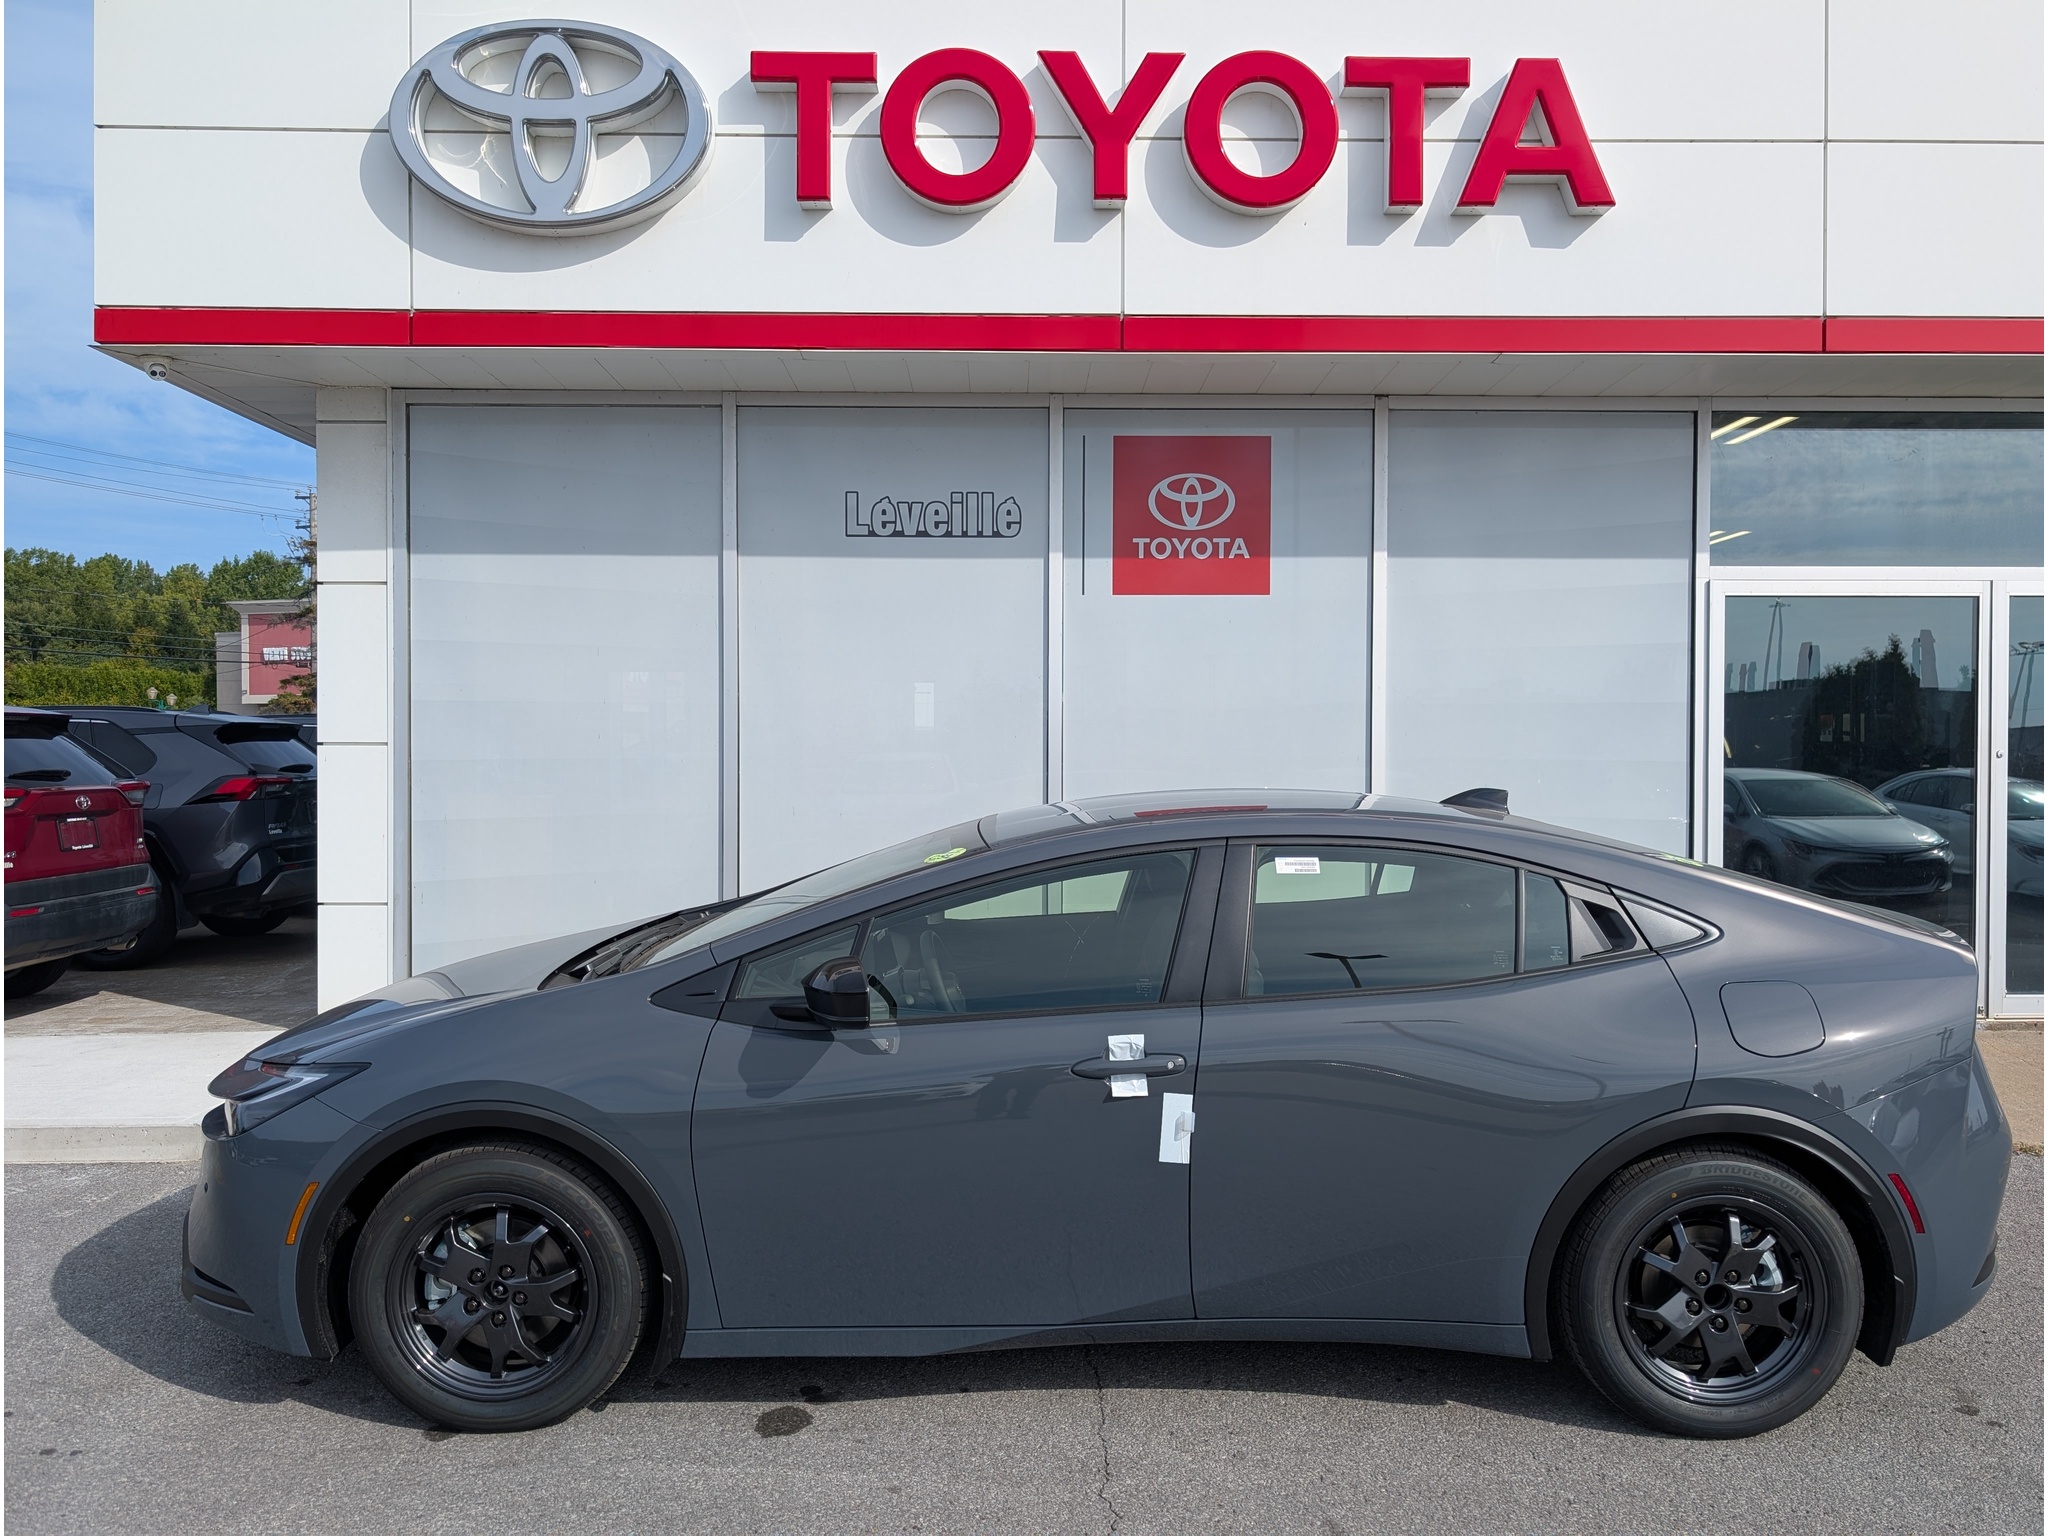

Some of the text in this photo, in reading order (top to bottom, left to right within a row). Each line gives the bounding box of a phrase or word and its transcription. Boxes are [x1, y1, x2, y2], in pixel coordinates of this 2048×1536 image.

[750, 47, 1617, 214] TOYOTA
[845, 491, 1022, 538] Léveillé
[1132, 537, 1251, 560] TOYOTA
[1699, 1164, 1809, 1201] BRIDGESTONE
